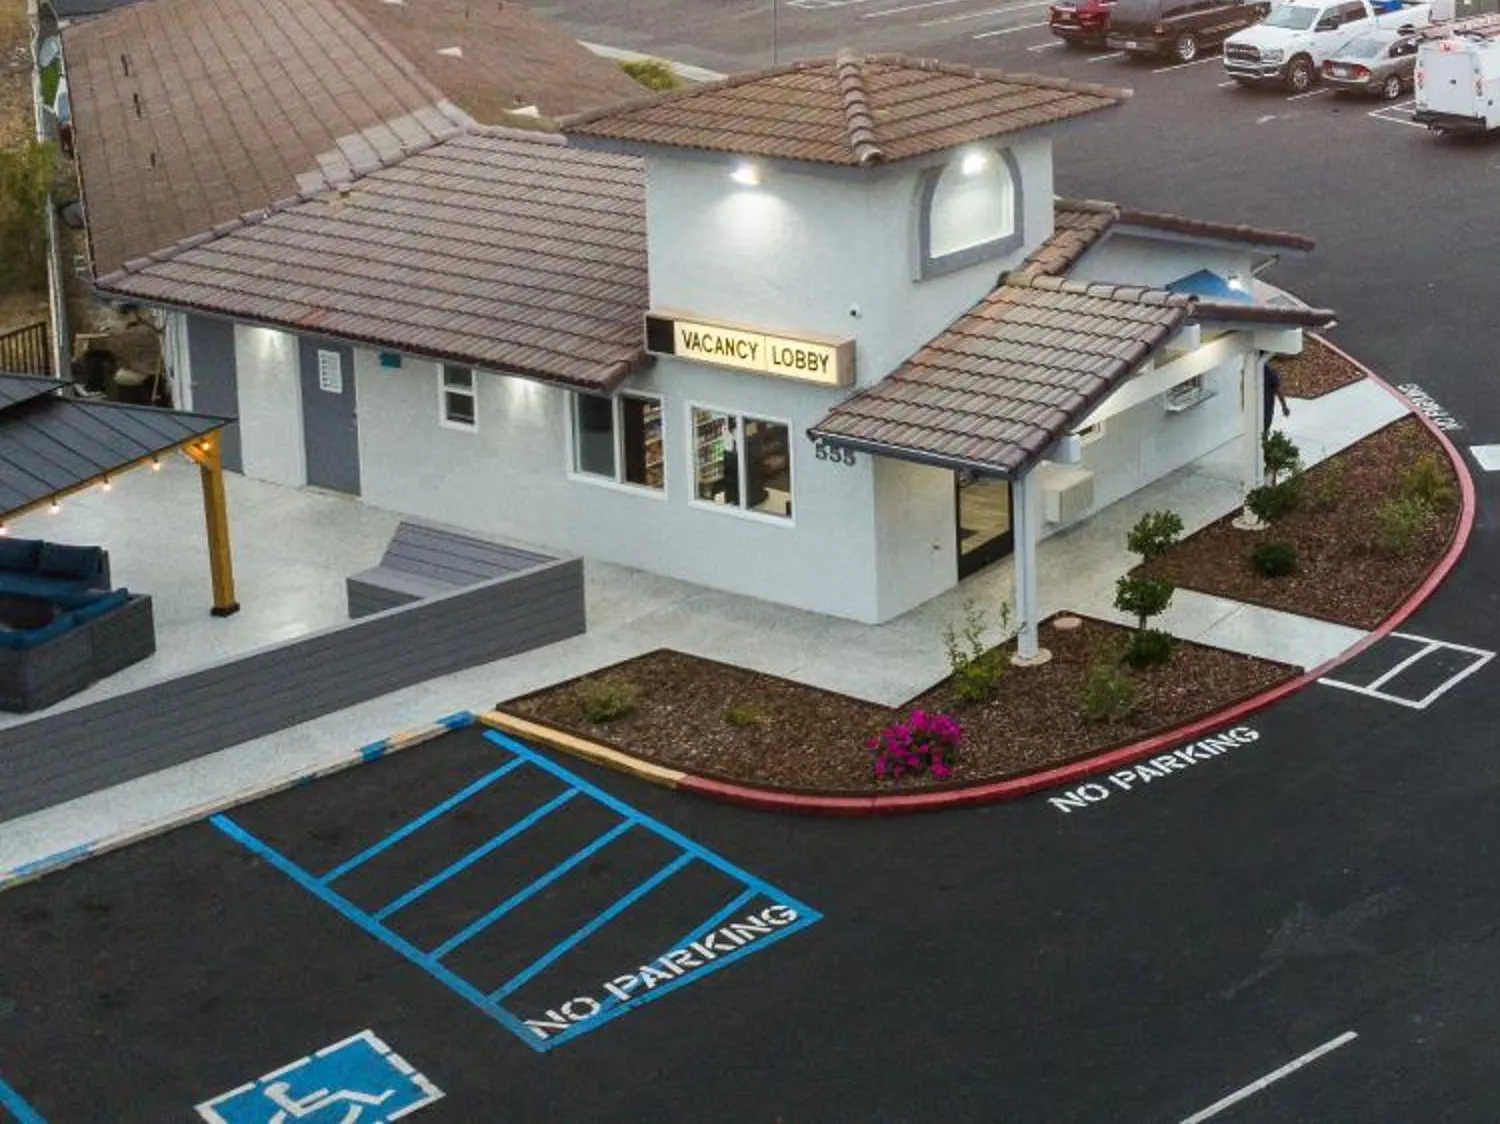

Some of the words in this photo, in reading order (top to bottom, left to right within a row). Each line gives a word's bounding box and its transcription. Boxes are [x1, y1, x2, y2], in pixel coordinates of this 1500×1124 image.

[681, 330, 759, 361] VACANCY
[772, 346, 829, 373] LOBBY
[815, 441, 856, 466] 555
[1048, 783, 1110, 813] NO
[1109, 726, 1260, 791] PARKING
[524, 996, 601, 1040] NO
[603, 904, 798, 1001] PARKING
